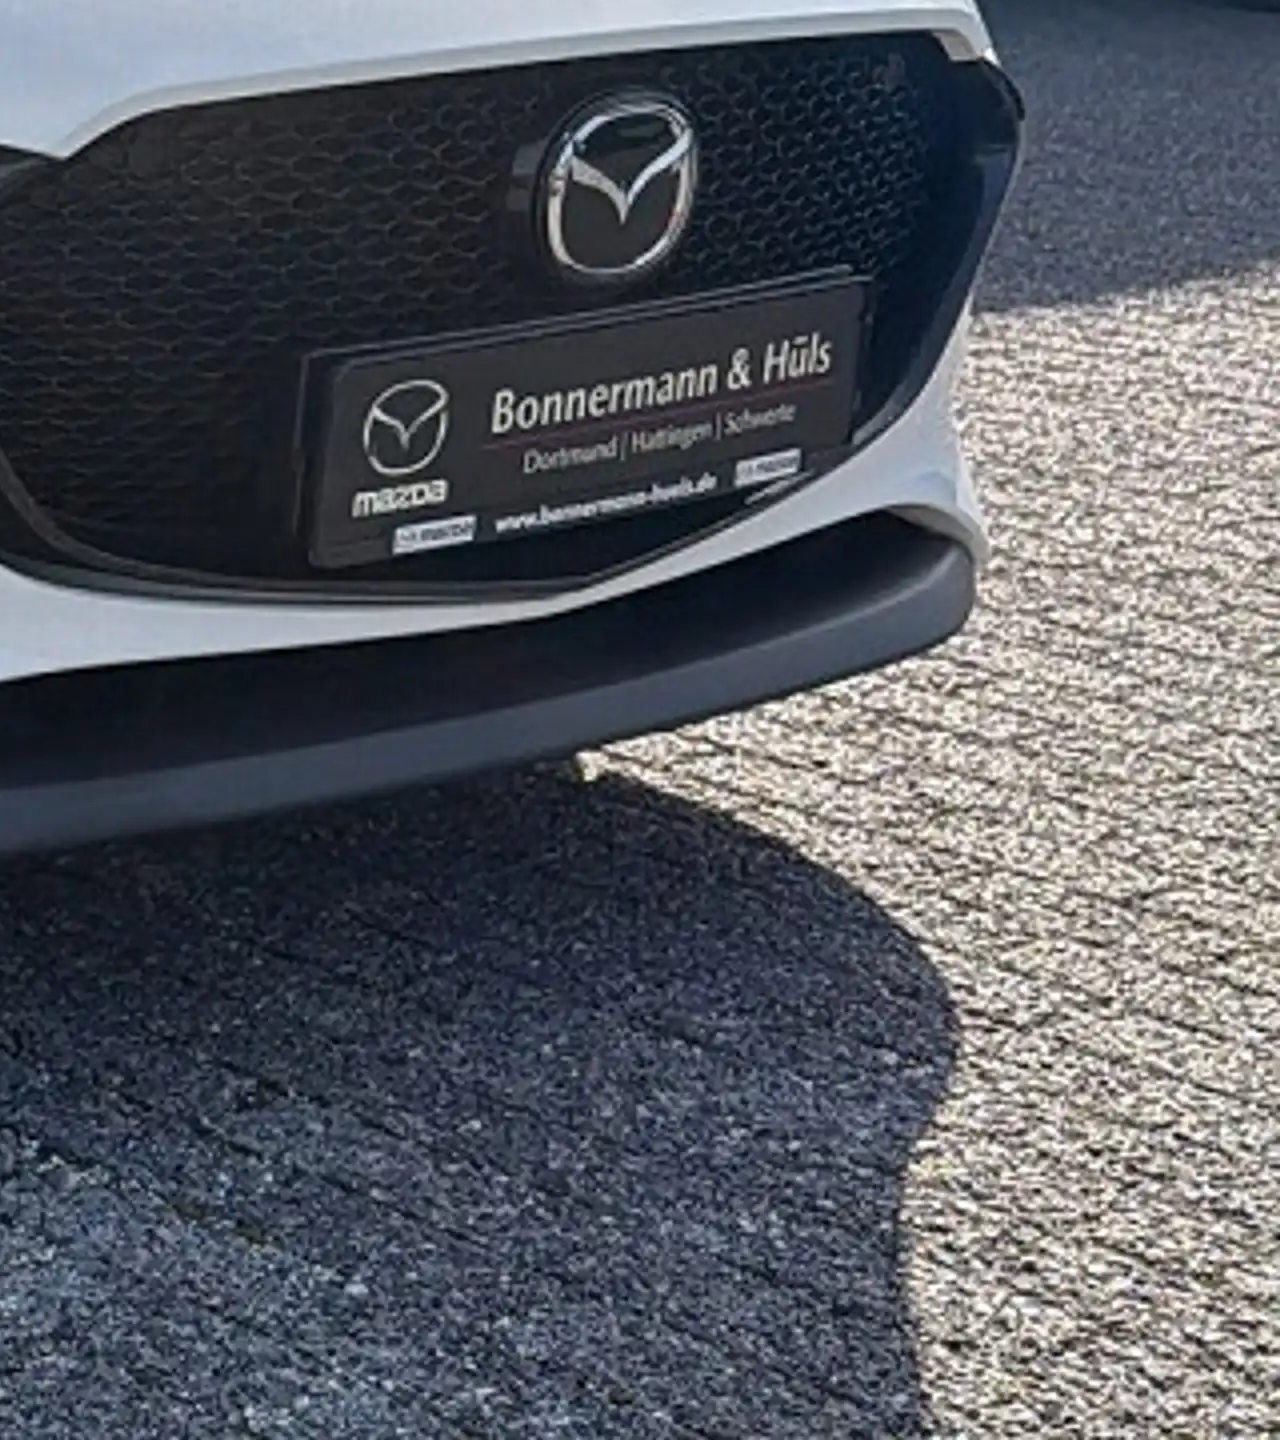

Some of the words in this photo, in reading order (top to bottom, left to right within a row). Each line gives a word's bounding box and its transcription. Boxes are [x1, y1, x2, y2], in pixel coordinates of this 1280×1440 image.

[491, 362, 718, 433] Bonnermann
[726, 347, 751, 390] &
[523, 436, 618, 474] Dortmund
